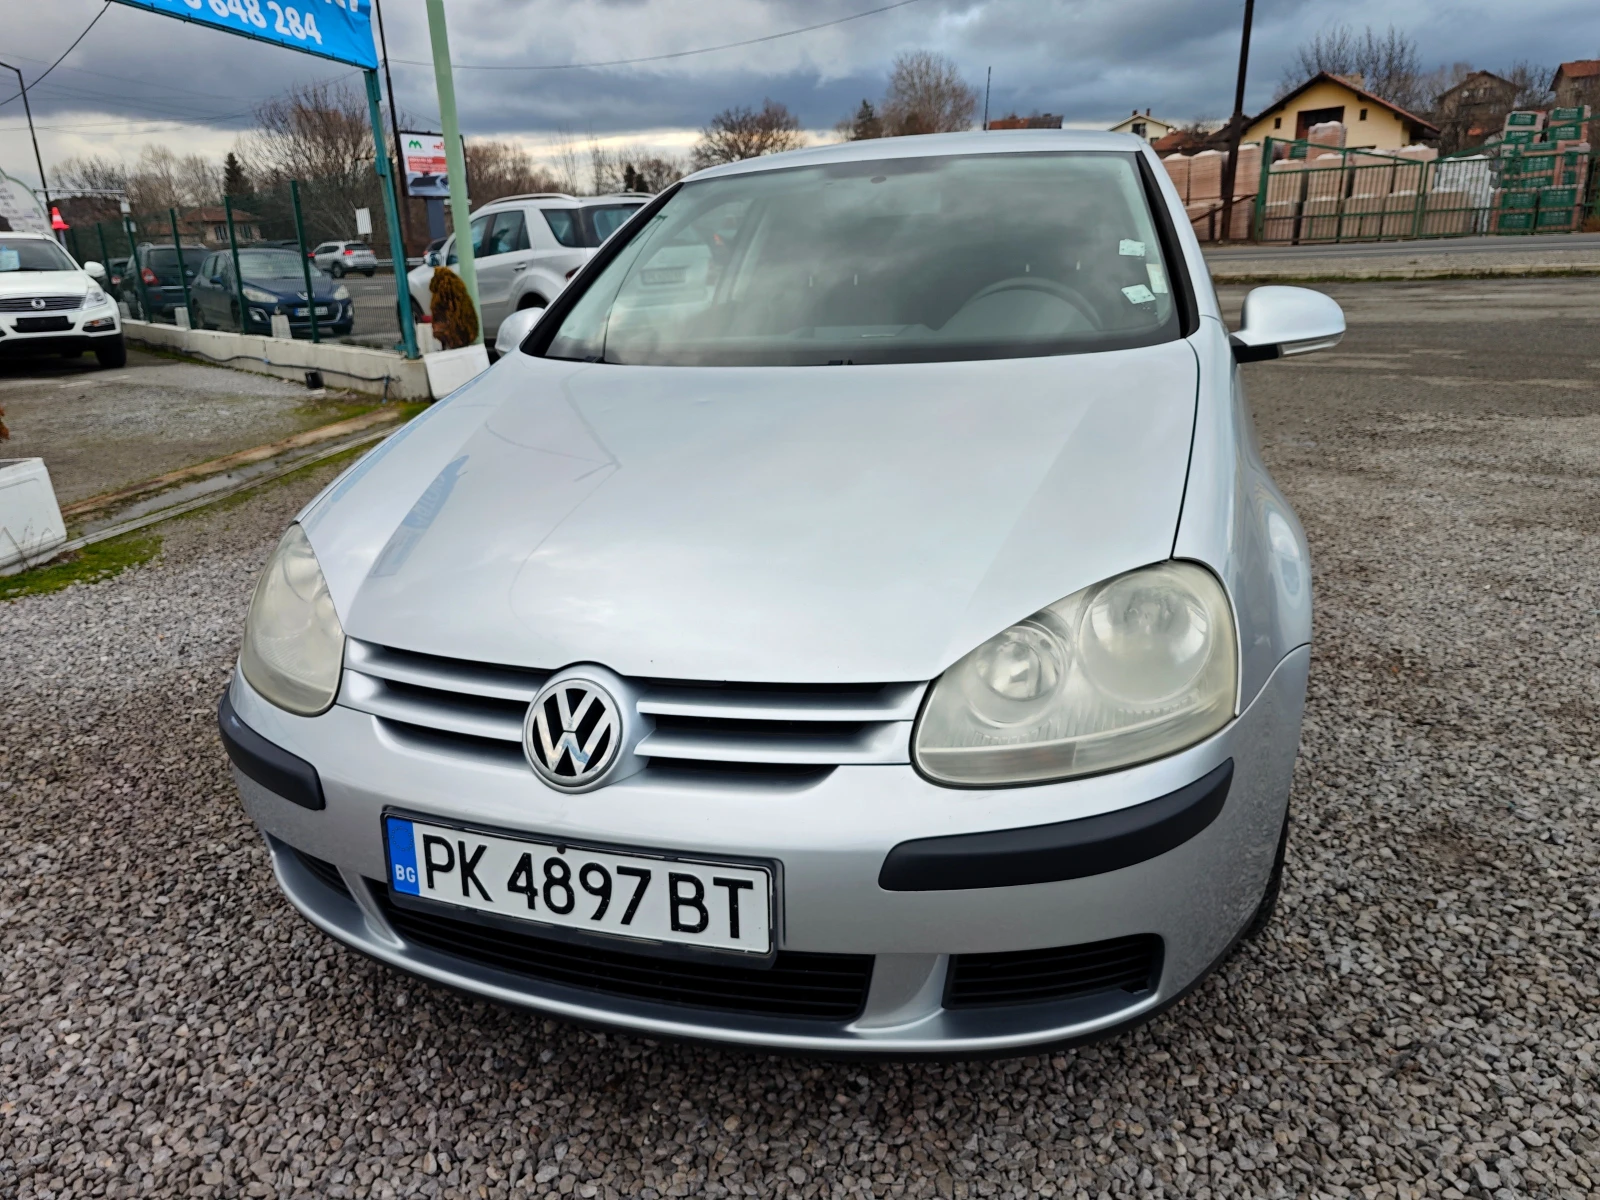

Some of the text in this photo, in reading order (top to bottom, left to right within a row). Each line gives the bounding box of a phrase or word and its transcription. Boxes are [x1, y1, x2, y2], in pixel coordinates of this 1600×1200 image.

[267, 1, 323, 46] 284
[395, 863, 416, 883] BG
[422, 833, 754, 939] PK 4897 BT
